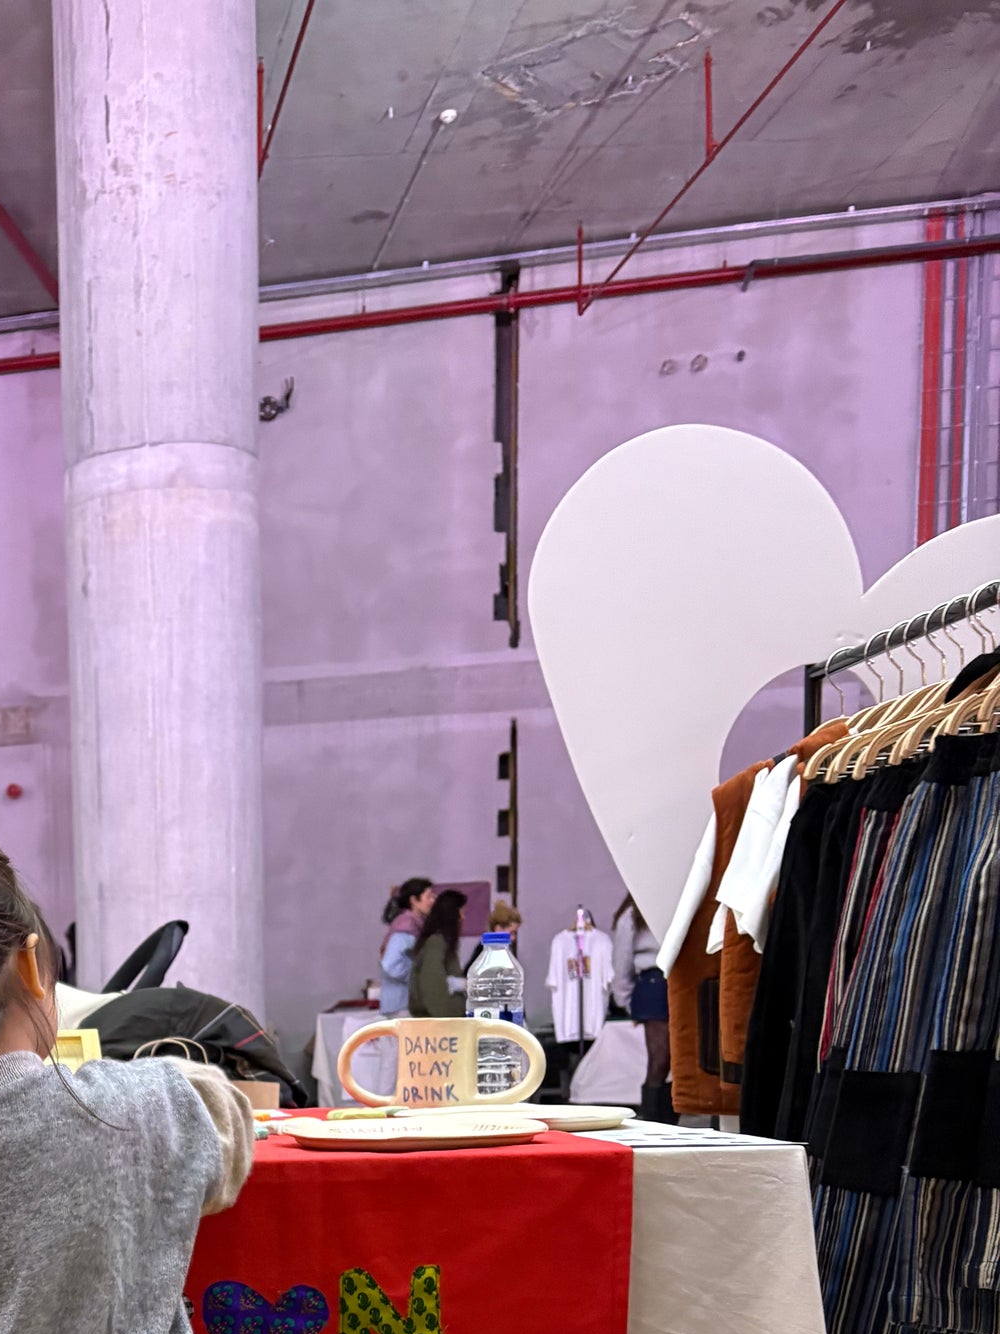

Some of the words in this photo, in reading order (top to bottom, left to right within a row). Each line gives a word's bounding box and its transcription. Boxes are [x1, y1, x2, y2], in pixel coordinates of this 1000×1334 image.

[404, 1036, 458, 1056] DANCE
[409, 1059, 453, 1078] PLAY
[402, 1084, 460, 1103] DRINK
